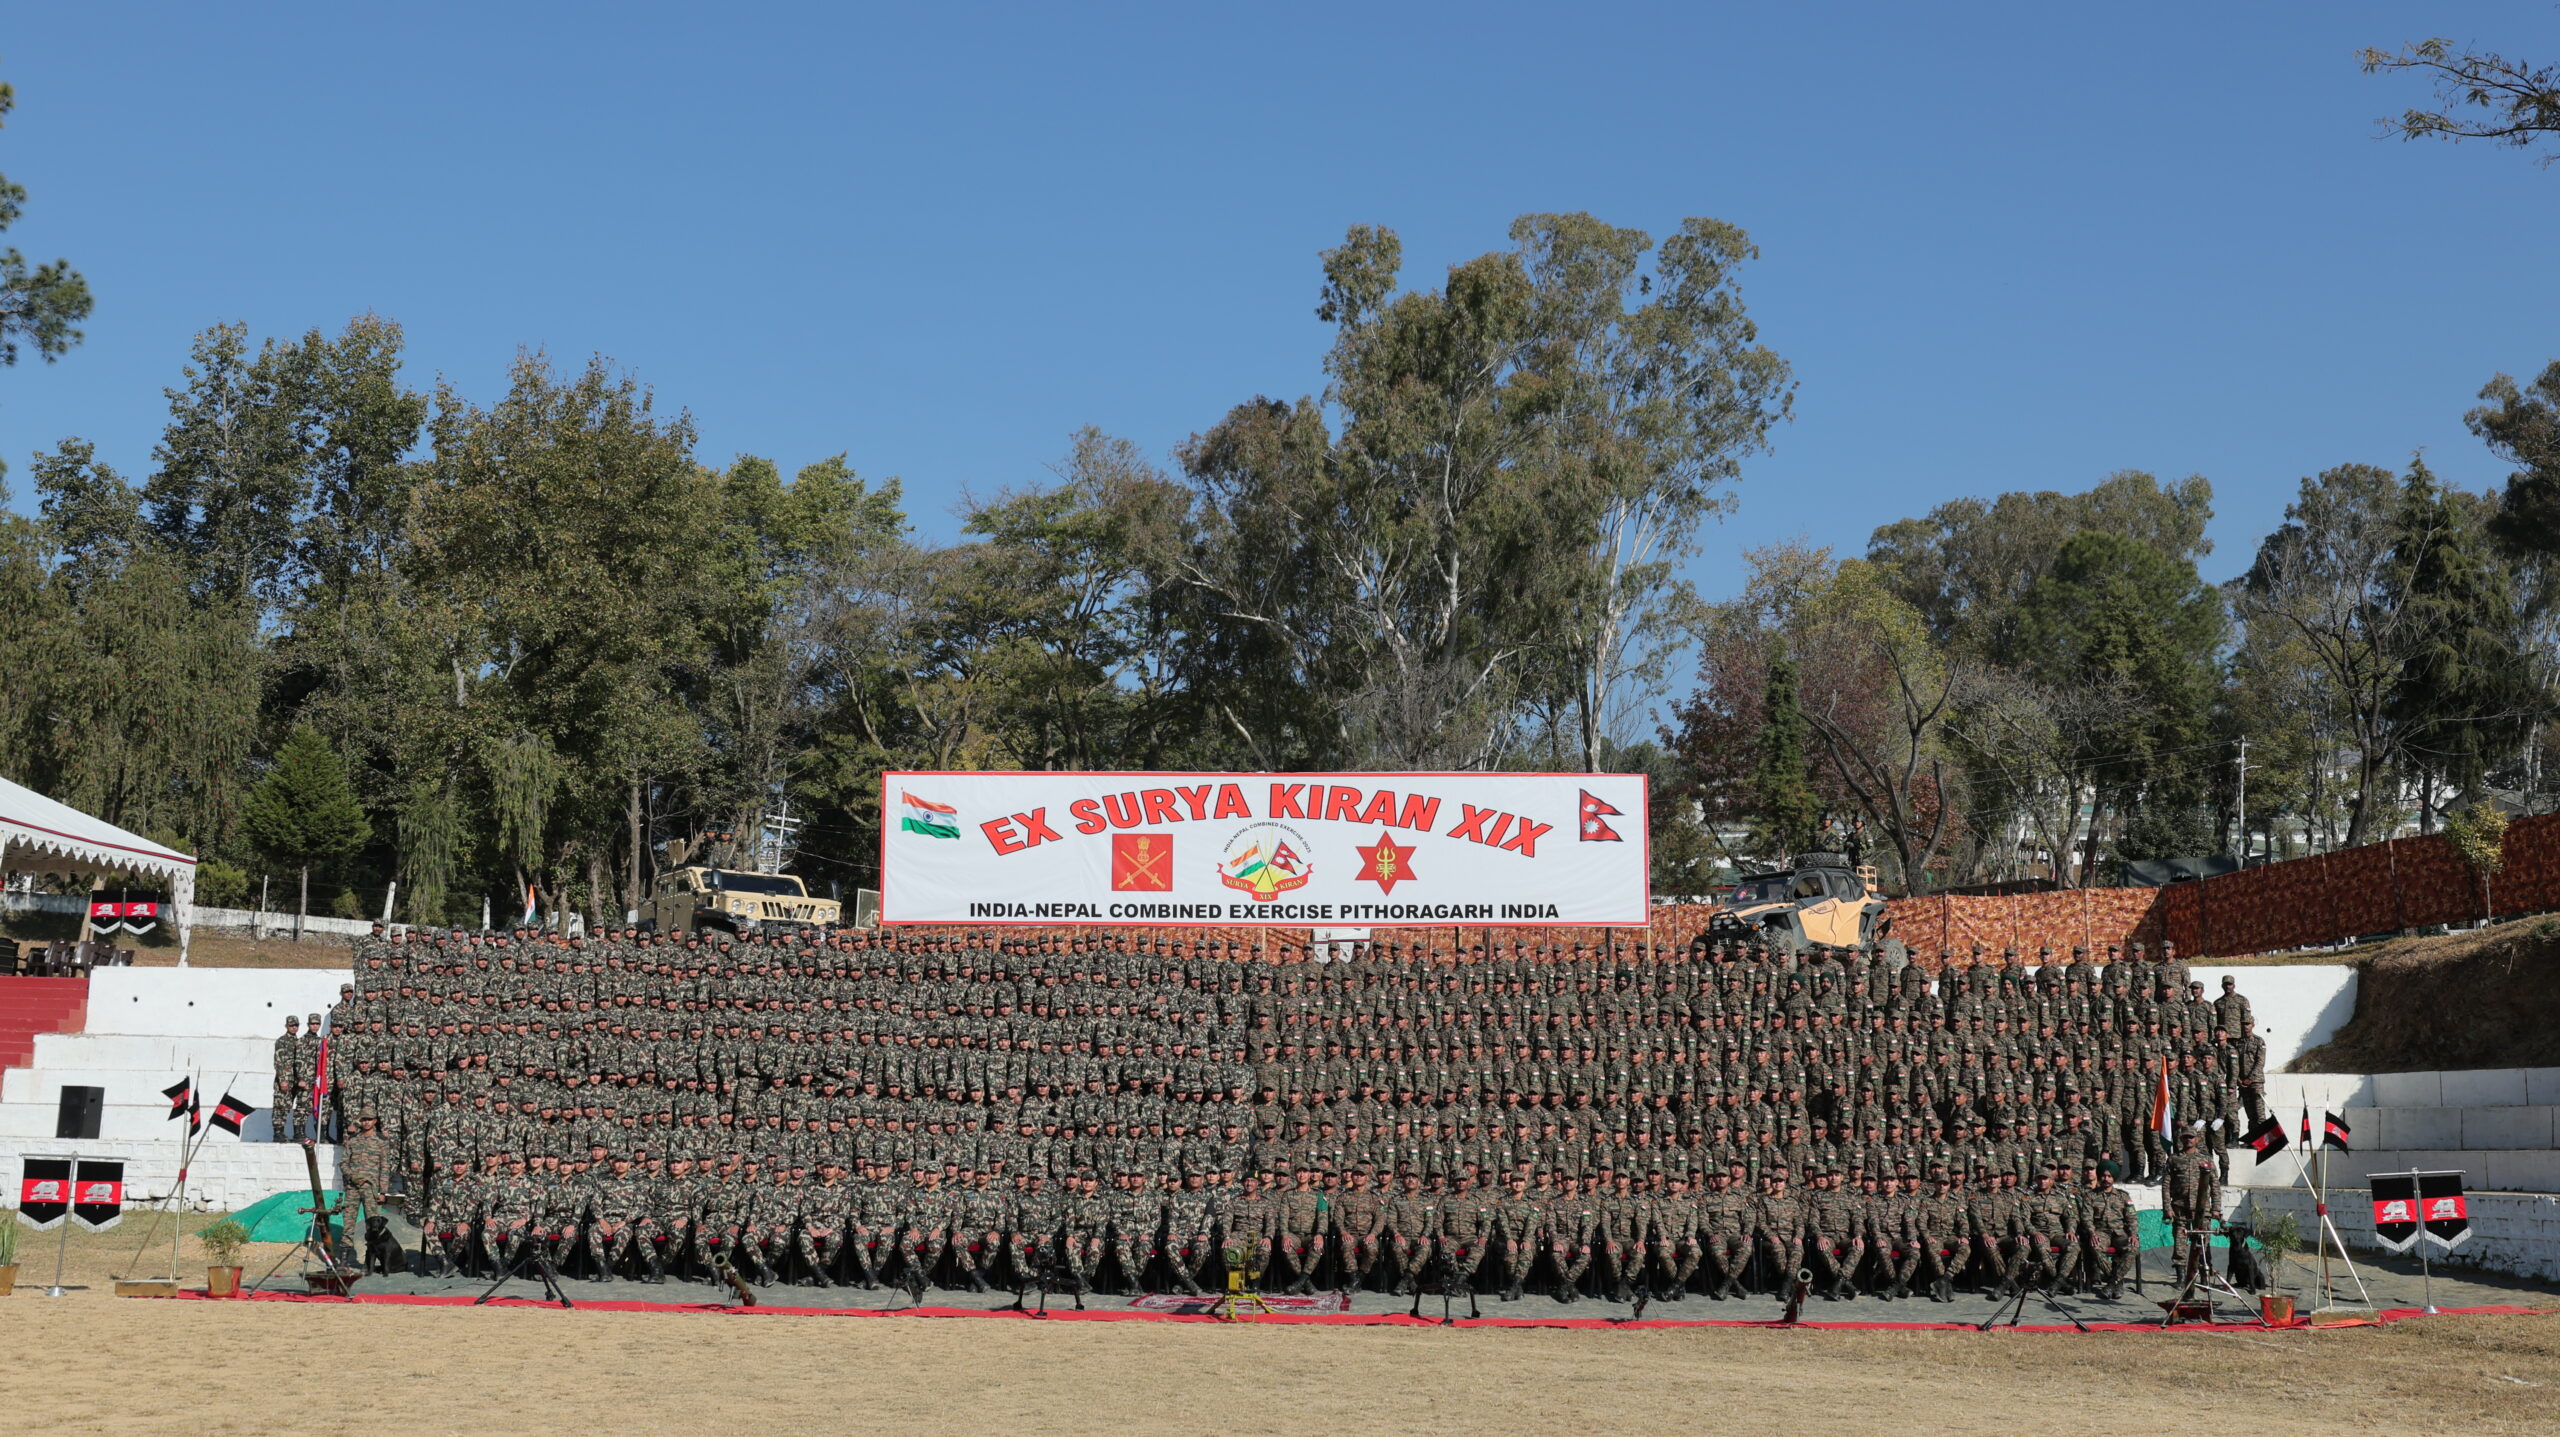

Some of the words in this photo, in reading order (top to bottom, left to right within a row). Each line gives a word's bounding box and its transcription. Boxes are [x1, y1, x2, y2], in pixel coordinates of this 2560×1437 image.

[979, 807, 1063, 856] EX
[1068, 783, 1253, 836] SURYA
[1269, 783, 1442, 832] KIRAN
[1447, 803, 1554, 858] XIX
[1249, 821, 1279, 829] COMBINED
[1226, 878, 1249, 889] SURYA
[1280, 879, 1303, 889] KIRAN
[970, 903, 1102, 918] INDIA-NEPAL
[1109, 903, 1222, 919] COMBINED
[1229, 904, 1333, 919] EXERCISE
[1340, 904, 1493, 919] PITHORAGARH
[1501, 904, 1559, 918] INDIA
